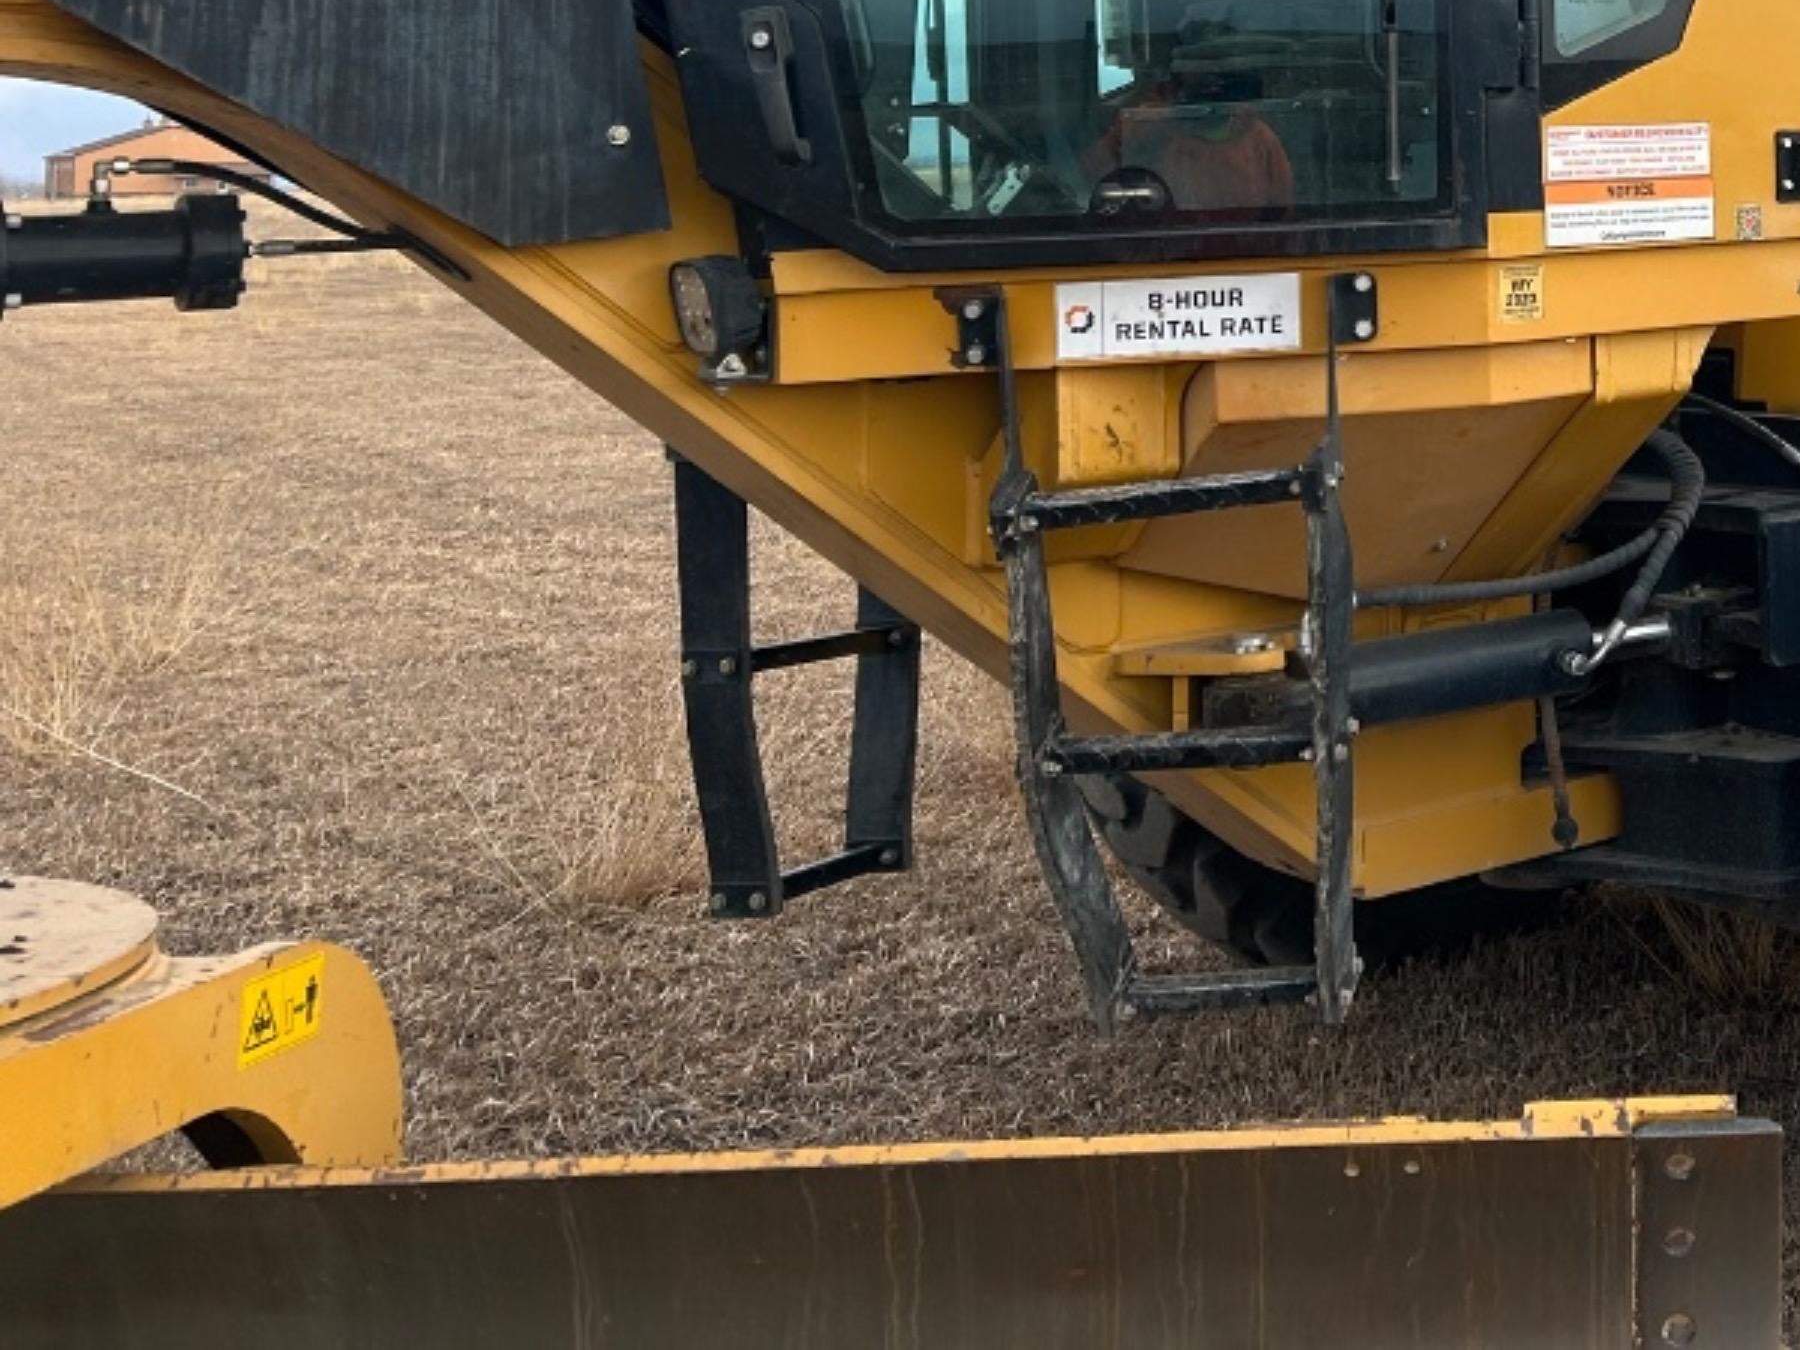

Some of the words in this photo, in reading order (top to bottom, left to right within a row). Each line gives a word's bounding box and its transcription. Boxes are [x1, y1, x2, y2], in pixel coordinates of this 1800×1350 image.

[1148, 287, 1244, 311] 8-HOUR
[1115, 318, 1212, 341] RENTAL
[1220, 314, 1284, 337] RATE
